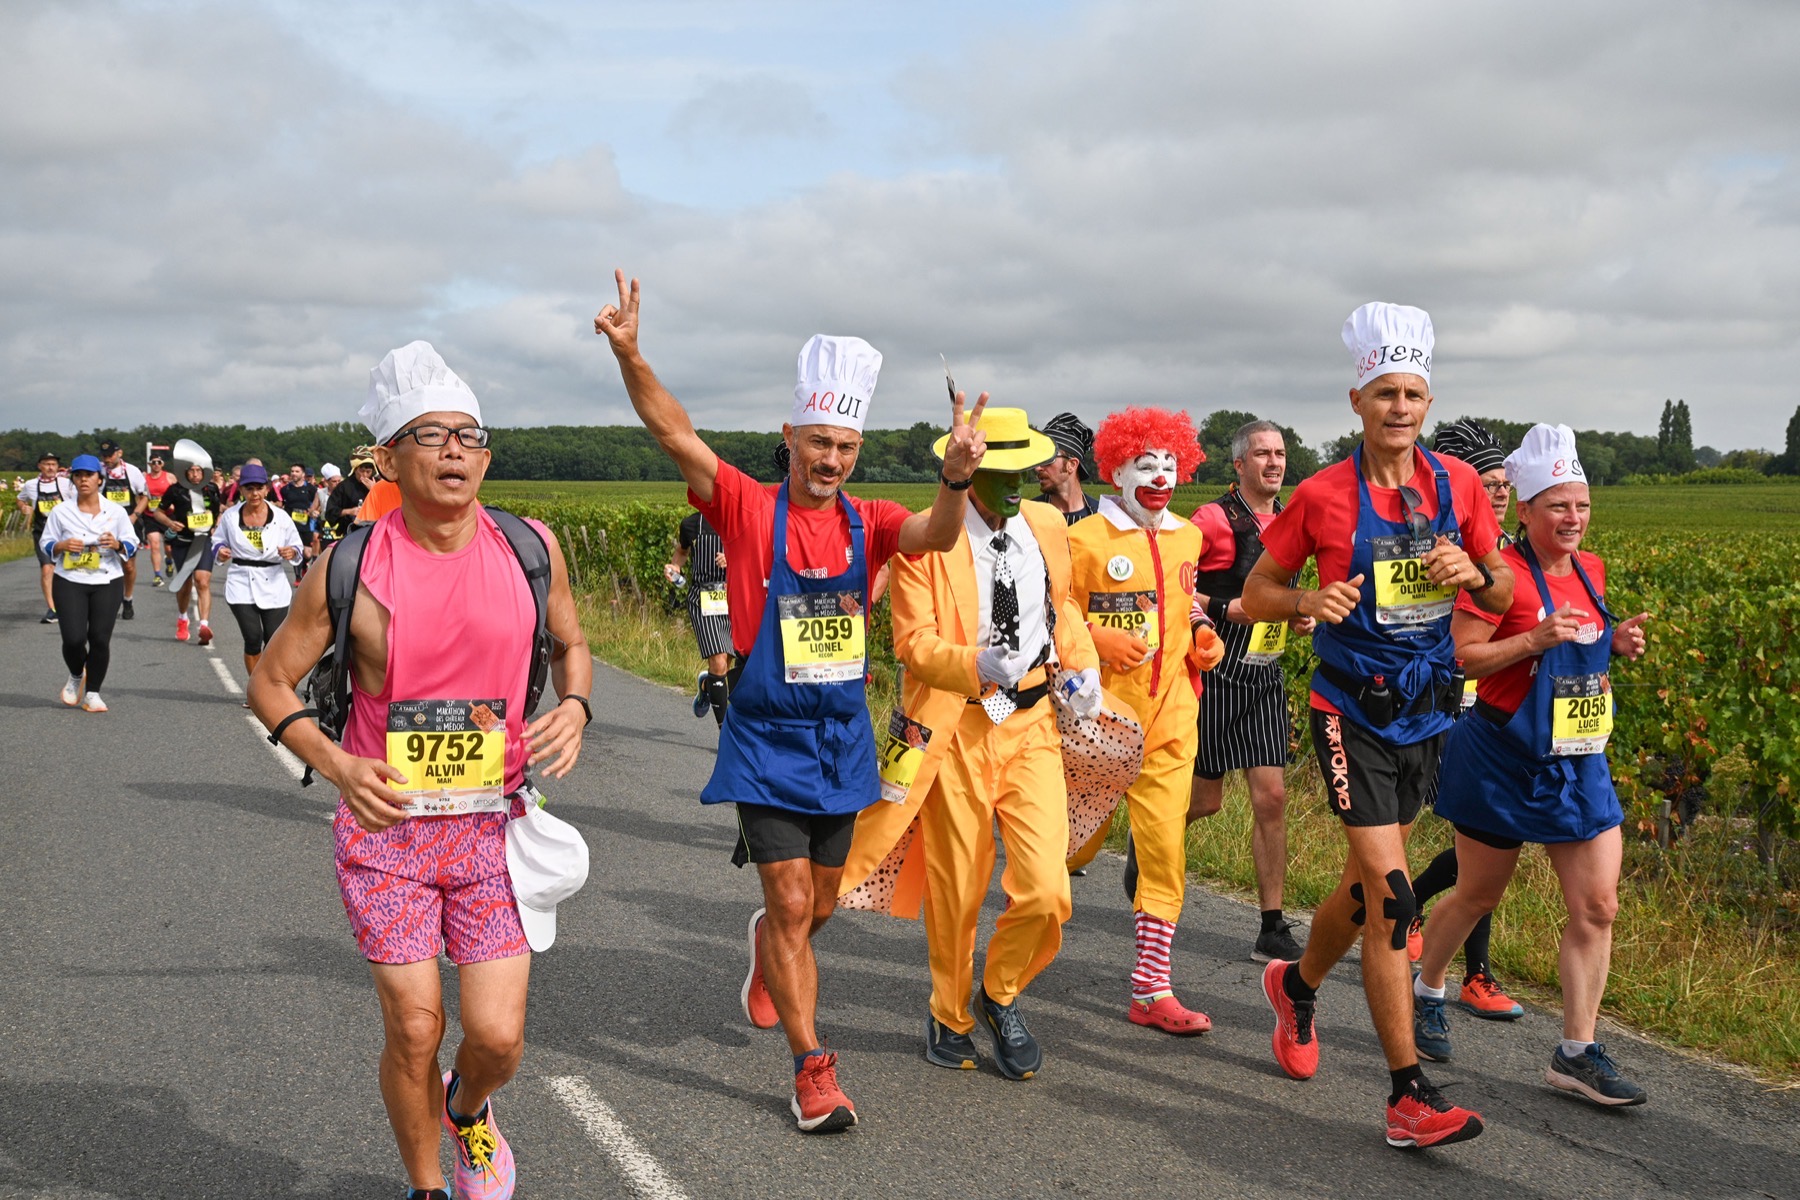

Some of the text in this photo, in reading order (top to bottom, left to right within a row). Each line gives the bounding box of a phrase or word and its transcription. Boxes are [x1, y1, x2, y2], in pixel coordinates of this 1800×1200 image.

[1390, 560, 1431, 584] 205
[1400, 583, 1438, 595] OLIVIER
[797, 618, 852, 642] 2059
[1099, 613, 1146, 631] 7039
[810, 642, 843, 653] LIONEL
[436, 707, 465, 716] MARATHON
[1567, 695, 1606, 719] 2058
[443, 722, 465, 731] MÉDOC
[1578, 718, 1599, 729] LUCIE
[406, 733, 484, 763] 9752
[885, 737, 910, 764] 77
[425, 763, 465, 777] ALVIN
[1330, 743, 1351, 811] TOKYO
